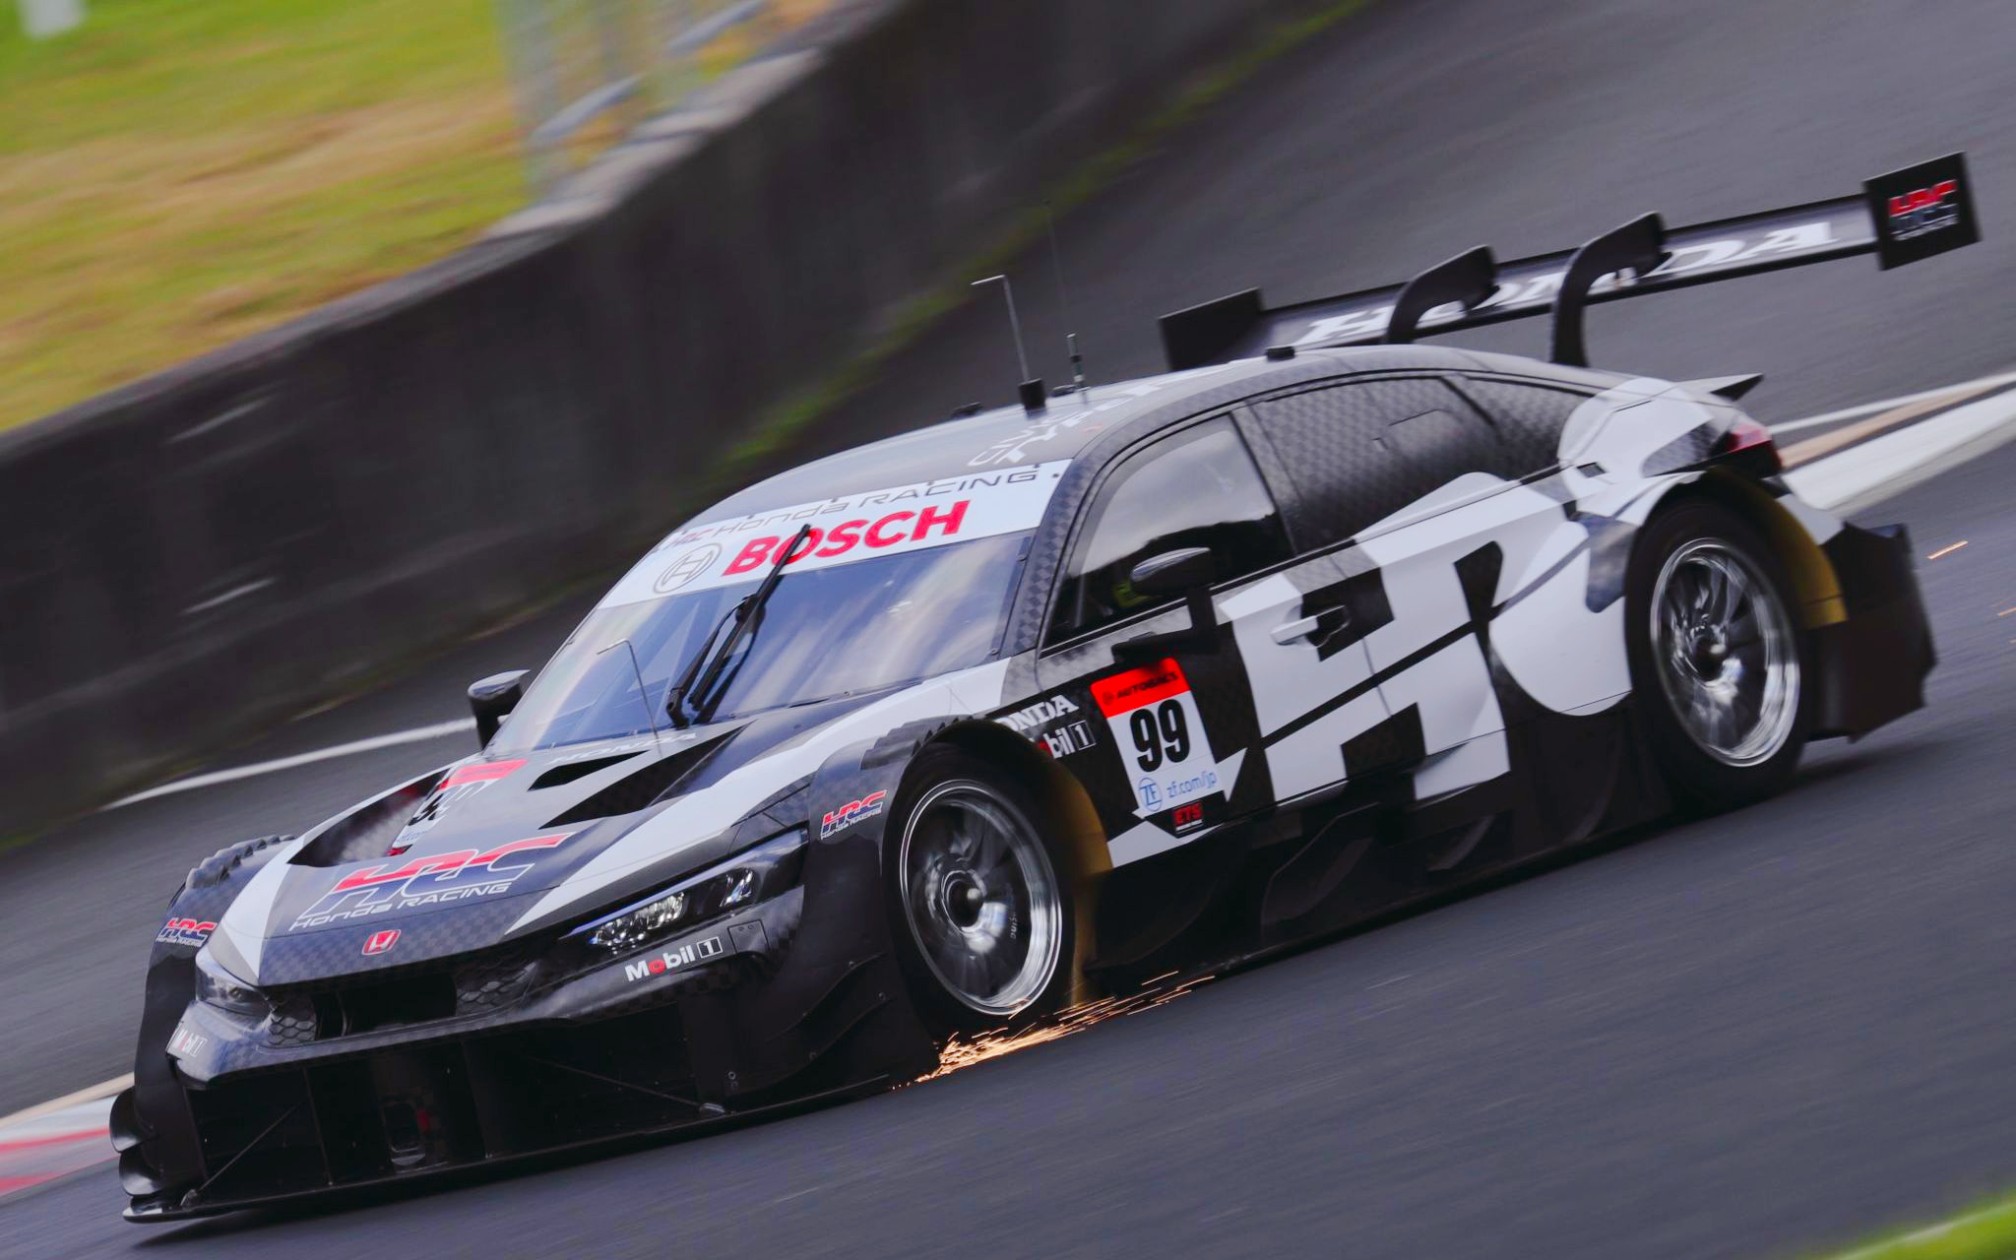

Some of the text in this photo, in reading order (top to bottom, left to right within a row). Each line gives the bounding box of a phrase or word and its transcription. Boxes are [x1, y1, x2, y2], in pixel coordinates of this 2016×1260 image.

[858, 470, 1040, 507] RACING
[722, 500, 970, 576] BOSCH
[1129, 698, 1191, 773] 99
[288, 881, 513, 932] Honda RACING
[624, 945, 696, 982] Mobil
